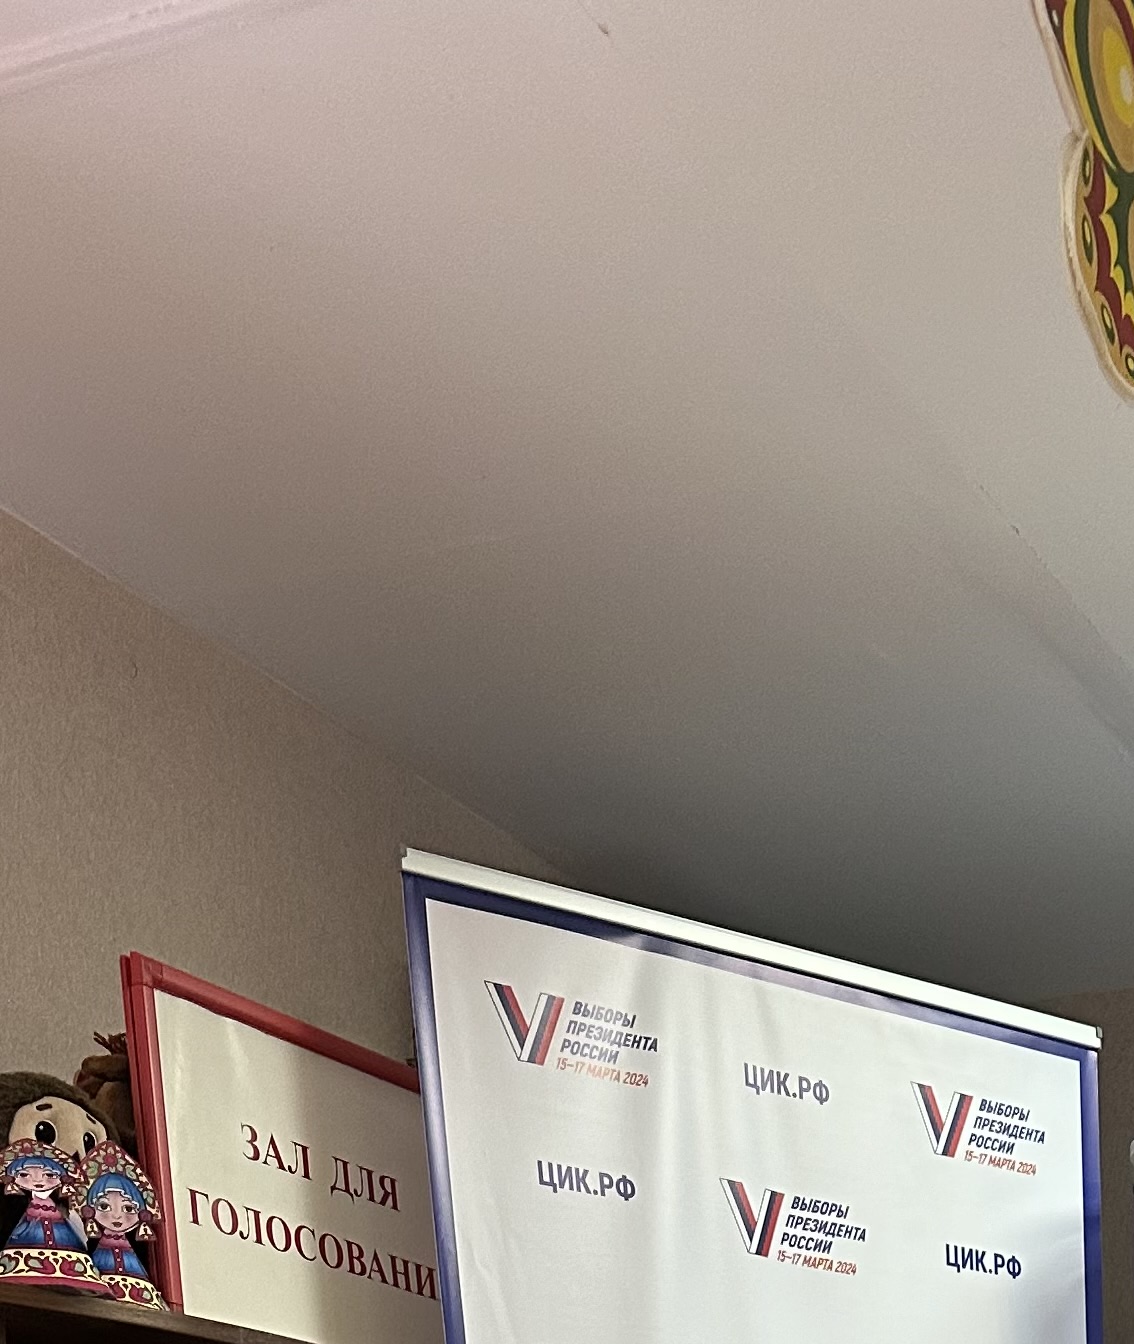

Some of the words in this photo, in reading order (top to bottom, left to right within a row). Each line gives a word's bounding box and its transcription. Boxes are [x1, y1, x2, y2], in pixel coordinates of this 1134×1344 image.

[572, 1000, 637, 1029] ВЫБОРЫ
[566, 1020, 658, 1052] ПРЕЗИДЕНТА
[560, 1038, 620, 1064] РОССИИ
[587, 1064, 620, 1083] МАРТА
[623, 1072, 649, 1087] 2024
[743, 1062, 830, 1104] ЦИК.РФ
[979, 1099, 1030, 1122] ВЫБОРЫ
[968, 1133, 1015, 1155] РОССИИ
[973, 1116, 1045, 1144] ПРЕЗИДЕНТА
[240, 1122, 311, 1180] ЗАЛ
[330, 1155, 399, 1213] ДЛЯ
[988, 1155, 1015, 1171] МАРТА
[1017, 1162, 1036, 1176] 2024
[536, 1159, 636, 1202] ЦИК.РФ
[791, 1196, 850, 1219] ВЫБОРЫ
[785, 1214, 866, 1242] ПРЕЗИДЕНТА
[188, 1187, 438, 1301] ГОЛОСОВАНИ
[780, 1232, 833, 1254] РОССИИ
[802, 1255, 833, 1271] МАРТА
[835, 1261, 857, 1275] 2024
[945, 1243, 1022, 1279] ЦИК.РФ
